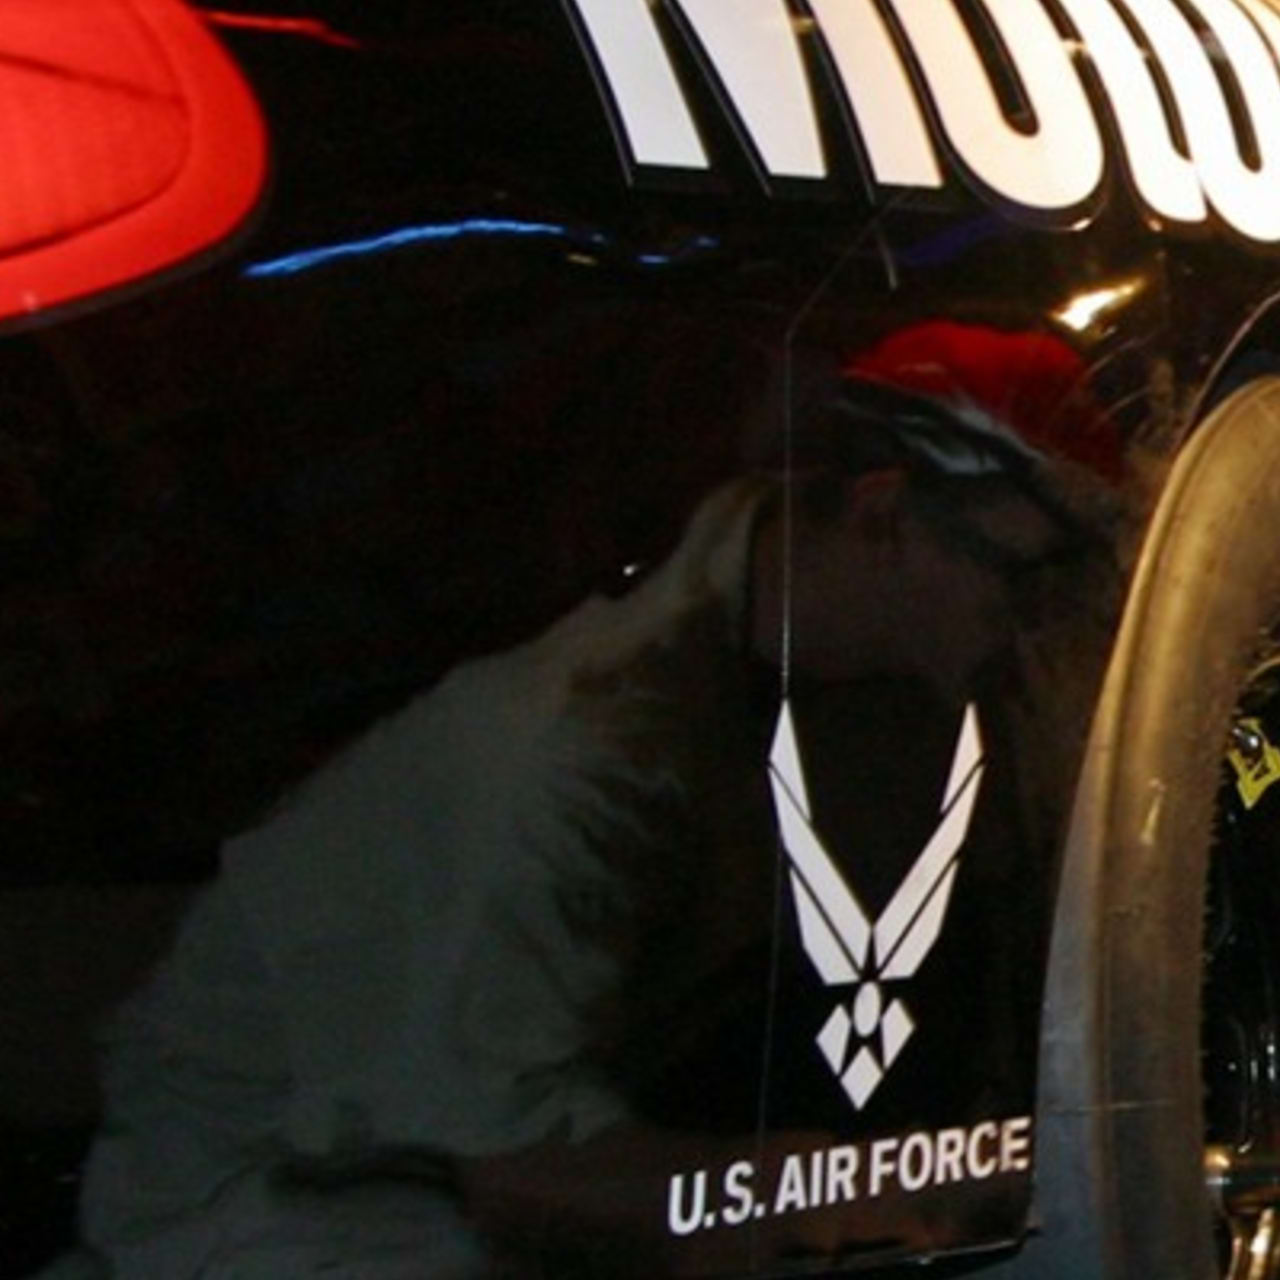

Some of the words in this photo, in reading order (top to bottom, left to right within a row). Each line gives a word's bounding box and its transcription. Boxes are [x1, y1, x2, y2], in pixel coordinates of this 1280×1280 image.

[668, 1161, 767, 1236] U.S.
[775, 1144, 860, 1216] AIR
[869, 1117, 1032, 1198] FORCE
